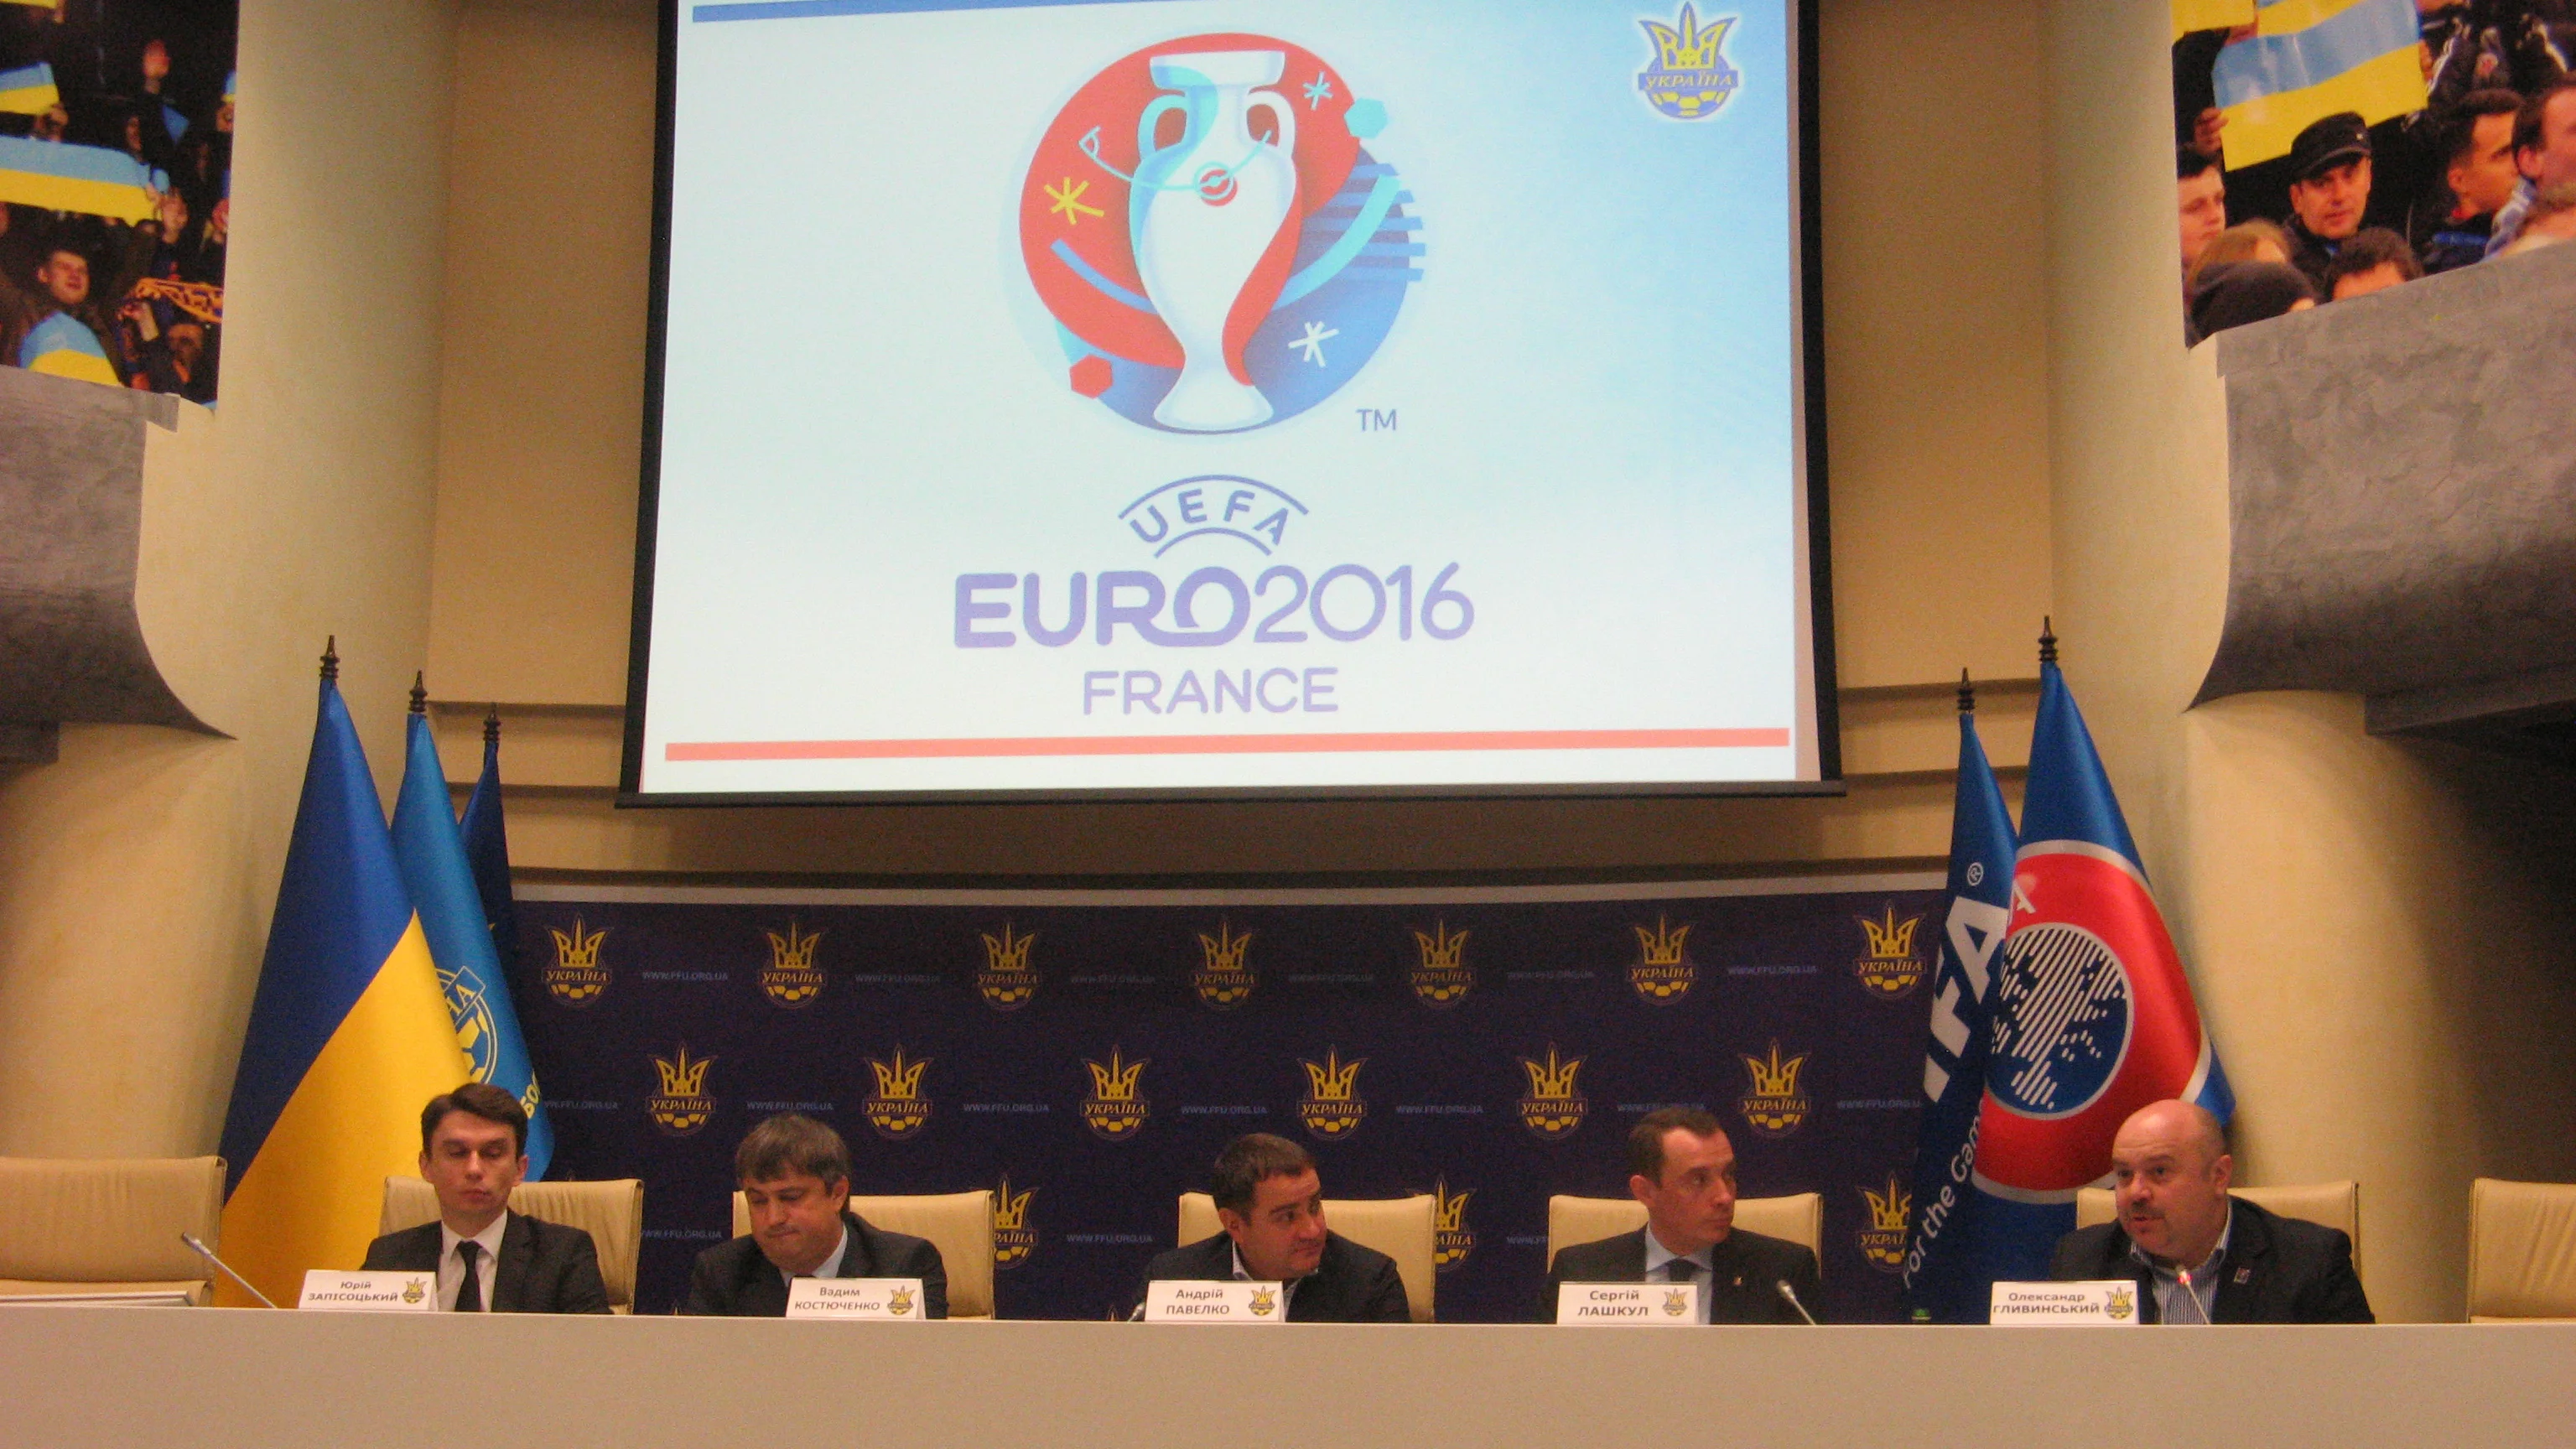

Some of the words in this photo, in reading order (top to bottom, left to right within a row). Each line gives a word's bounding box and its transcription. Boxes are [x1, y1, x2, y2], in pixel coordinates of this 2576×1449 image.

[1645, 68, 1733, 90] УКРАЇНА
[1356, 408, 1398, 432] TM
[1129, 488, 1290, 546] UEFA
[1083, 667, 1339, 715] FRANCE
[1630, 965, 1694, 979] УКРАЇНА
[1858, 958, 1924, 974] УКРАЇНА
[545, 969, 608, 982] УКРАЇНА
[761, 970, 823, 984] УКРАЇНА
[977, 972, 1038, 984] УКРАЇНА
[1194, 971, 1256, 984] УКРАЇНА
[1410, 970, 1472, 983] УКРАЇНА
[1923, 896, 2009, 1104] IFA
[543, 1099, 619, 1110] WW.FFU.ORG.UA
[650, 1097, 712, 1111] УКРАЇНА
[866, 1099, 929, 1114] УКРАЇНА
[1084, 1101, 1146, 1115] УКРАЇНА
[1300, 1101, 1363, 1115] УКРАЇНА
[1521, 1100, 1584, 1114] УКРАЇНА
[1743, 1097, 1808, 1112] УКРАЇНА
[1836, 1100, 1921, 1110] WWW.FFU.ORG.U
[1922, 1184, 1956, 1239] the
[994, 1229, 1036, 1244] РАЇНА
[1436, 1232, 1472, 1246] АЇНА
[1860, 1233, 1907, 1246] УКРАЇ
[340, 1280, 372, 1291] Юрій
[819, 1286, 860, 1297] Вадим
[308, 1291, 399, 1302] ЗАПІСОЦЬКИЙ
[1176, 1289, 1223, 1300] Андрій
[1589, 1290, 1639, 1301] Сергій
[2007, 1292, 2085, 1302] Олександр
[795, 1301, 880, 1311] КОСТЮЧЕНКО
[1166, 1305, 1230, 1315] ПАВЕЛКО
[1577, 1306, 1649, 1317] ЛАШКУЛ
[1992, 1302, 2101, 1314] ГЛИВИНСЬКИЙ
